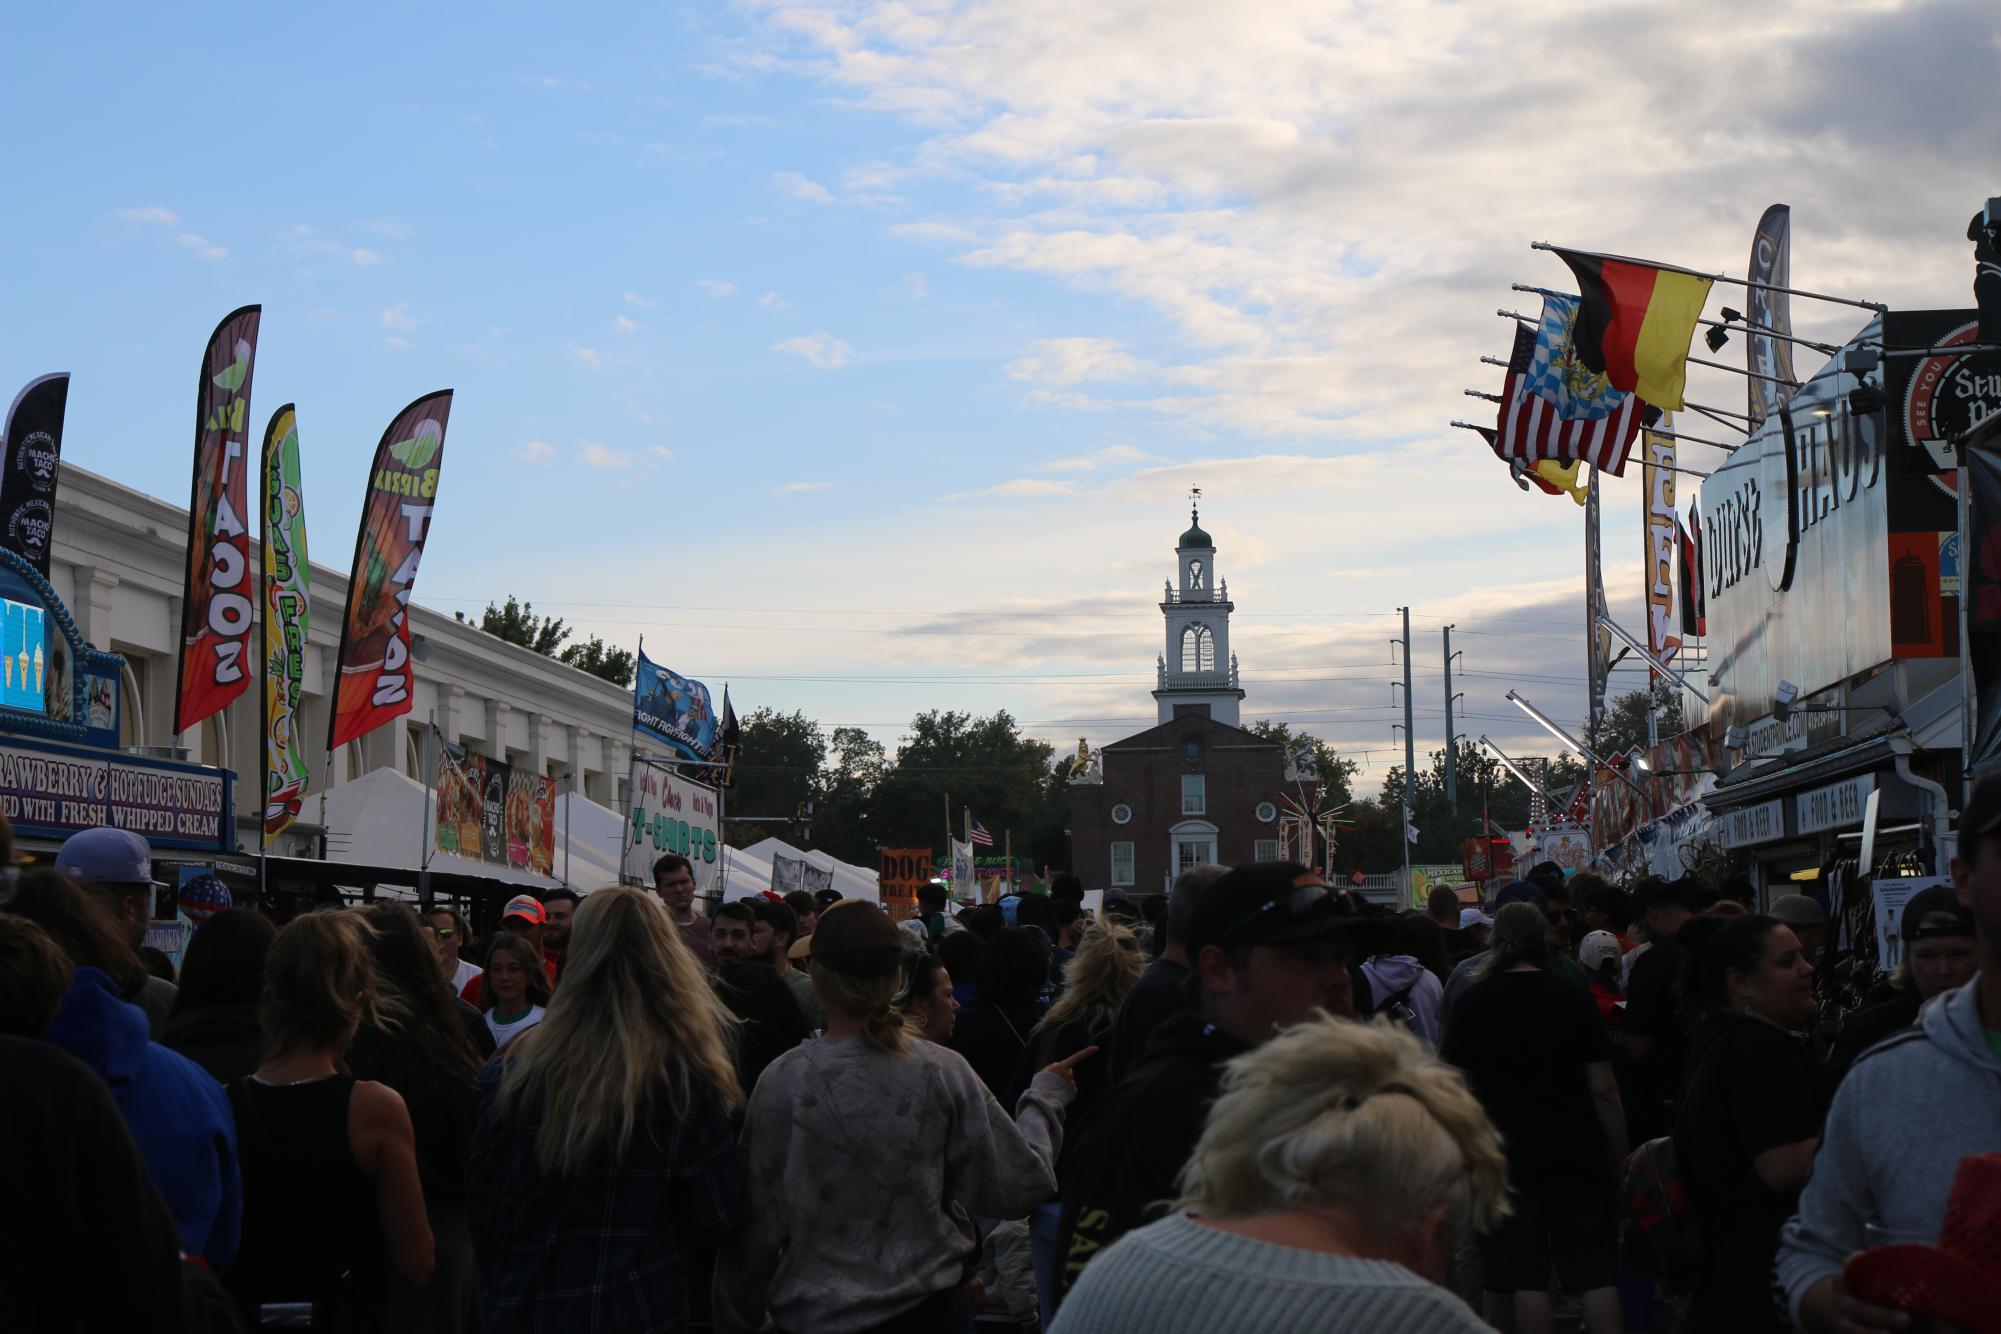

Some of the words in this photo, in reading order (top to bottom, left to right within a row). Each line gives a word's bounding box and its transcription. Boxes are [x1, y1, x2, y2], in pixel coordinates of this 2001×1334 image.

[1919, 361, 1942, 391] YOU
[1915, 400, 1927, 426] SEE
[33, 458, 53, 471] TACO
[26, 526, 46, 540] TACO
[94, 768, 108, 800] &
[110, 768, 136, 802] HOT
[137, 773, 173, 807] FUDGE
[174, 778, 222, 813] SUNDAES
[1811, 793, 1828, 825] FOOD
[1839, 782, 1859, 819] BEER
[22, 797, 56, 821] WITH
[61, 800, 107, 827] FRESH
[111, 805, 175, 832] WHIPPED
[177, 813, 219, 837] CREAM
[1734, 813, 1747, 841] FOOD
[1756, 807, 1770, 837] BEER
[883, 855, 929, 881] DOG
